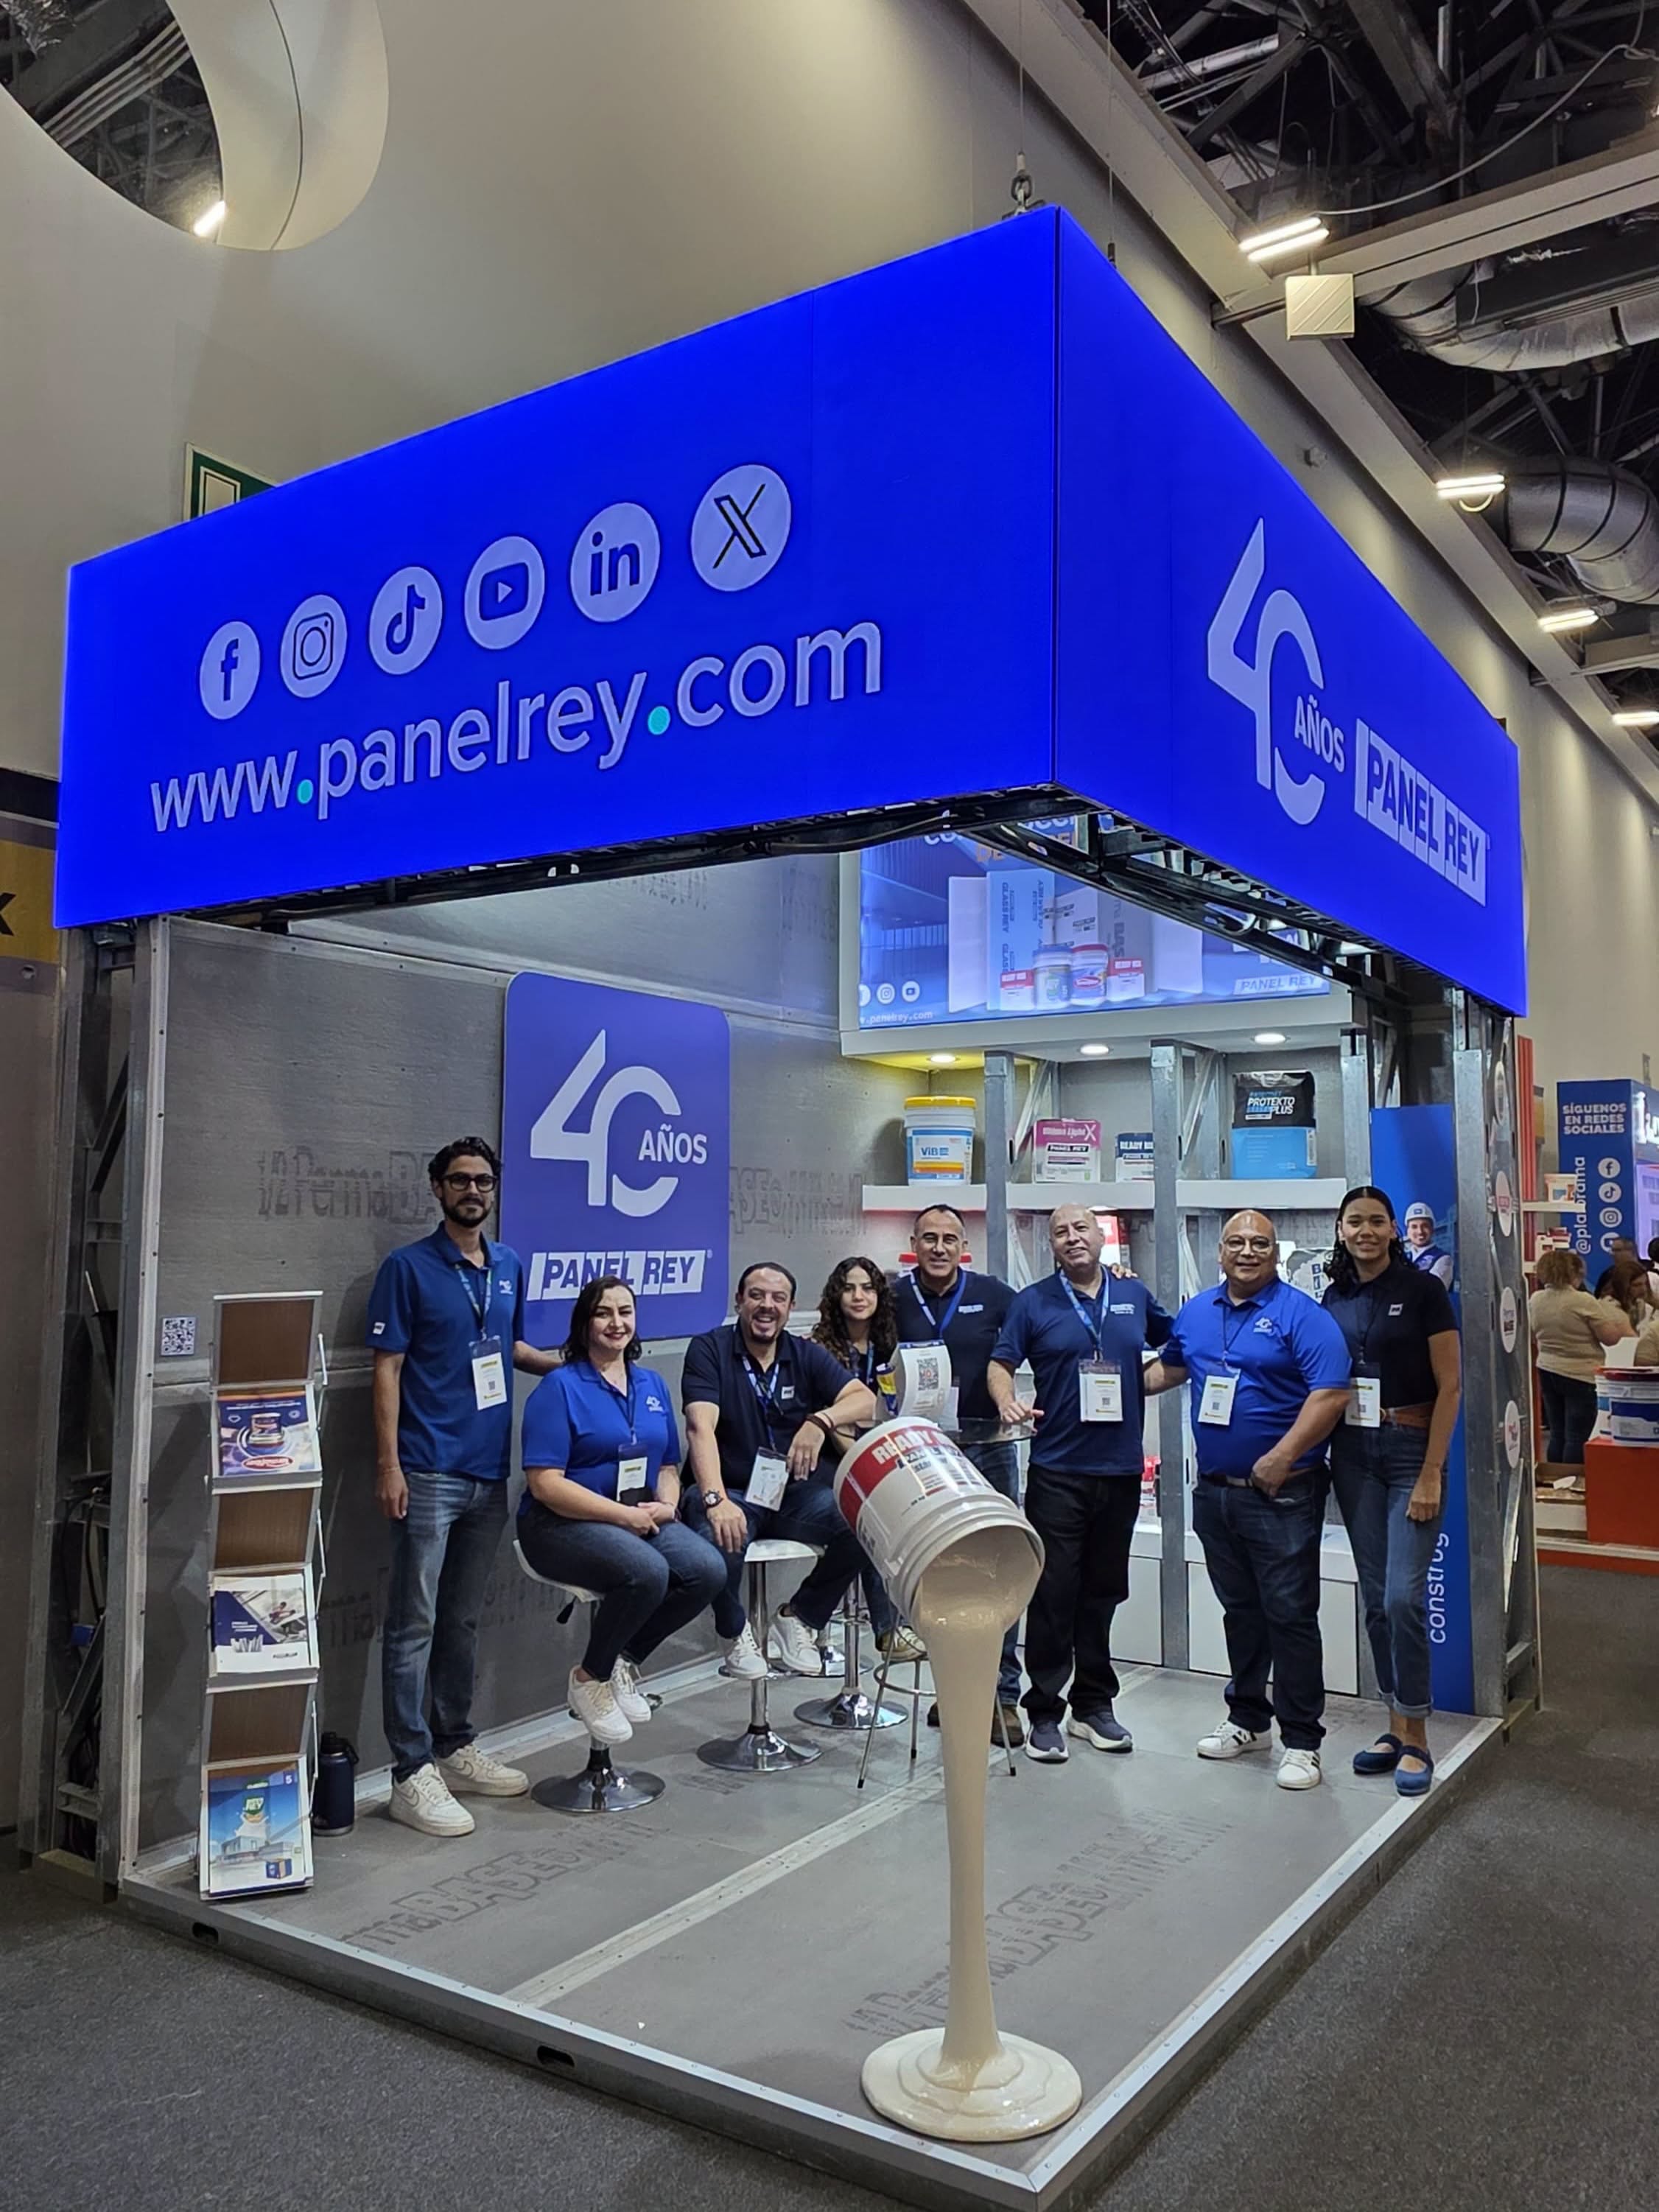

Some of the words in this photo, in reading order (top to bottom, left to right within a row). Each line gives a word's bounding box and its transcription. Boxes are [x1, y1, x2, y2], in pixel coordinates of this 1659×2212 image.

[150, 621, 881, 833] www.panelrey.com
[1294, 693, 1344, 773] AÑOS
[1367, 742, 1439, 854] PANEL
[1445, 809, 1479, 882] REY
[1241, 978, 1284, 991] PANEL
[1289, 975, 1316, 987] REY
[1248, 1096, 1296, 1106] PROTEKTO
[1272, 1105, 1294, 1115] PLUS
[1562, 1102, 1627, 1114] SÍGUENOS
[1563, 1124, 1625, 1135] SOCIALES
[1565, 1115, 1581, 1125] EN
[1585, 1113, 1624, 1124] REDES
[638, 1124, 708, 1165] AÑOS
[1574, 1157, 1592, 1254] @plarama
[542, 1256, 635, 1289] PANEL
[643, 1256, 695, 1287] REY
[871, 1430, 933, 1465] READY
